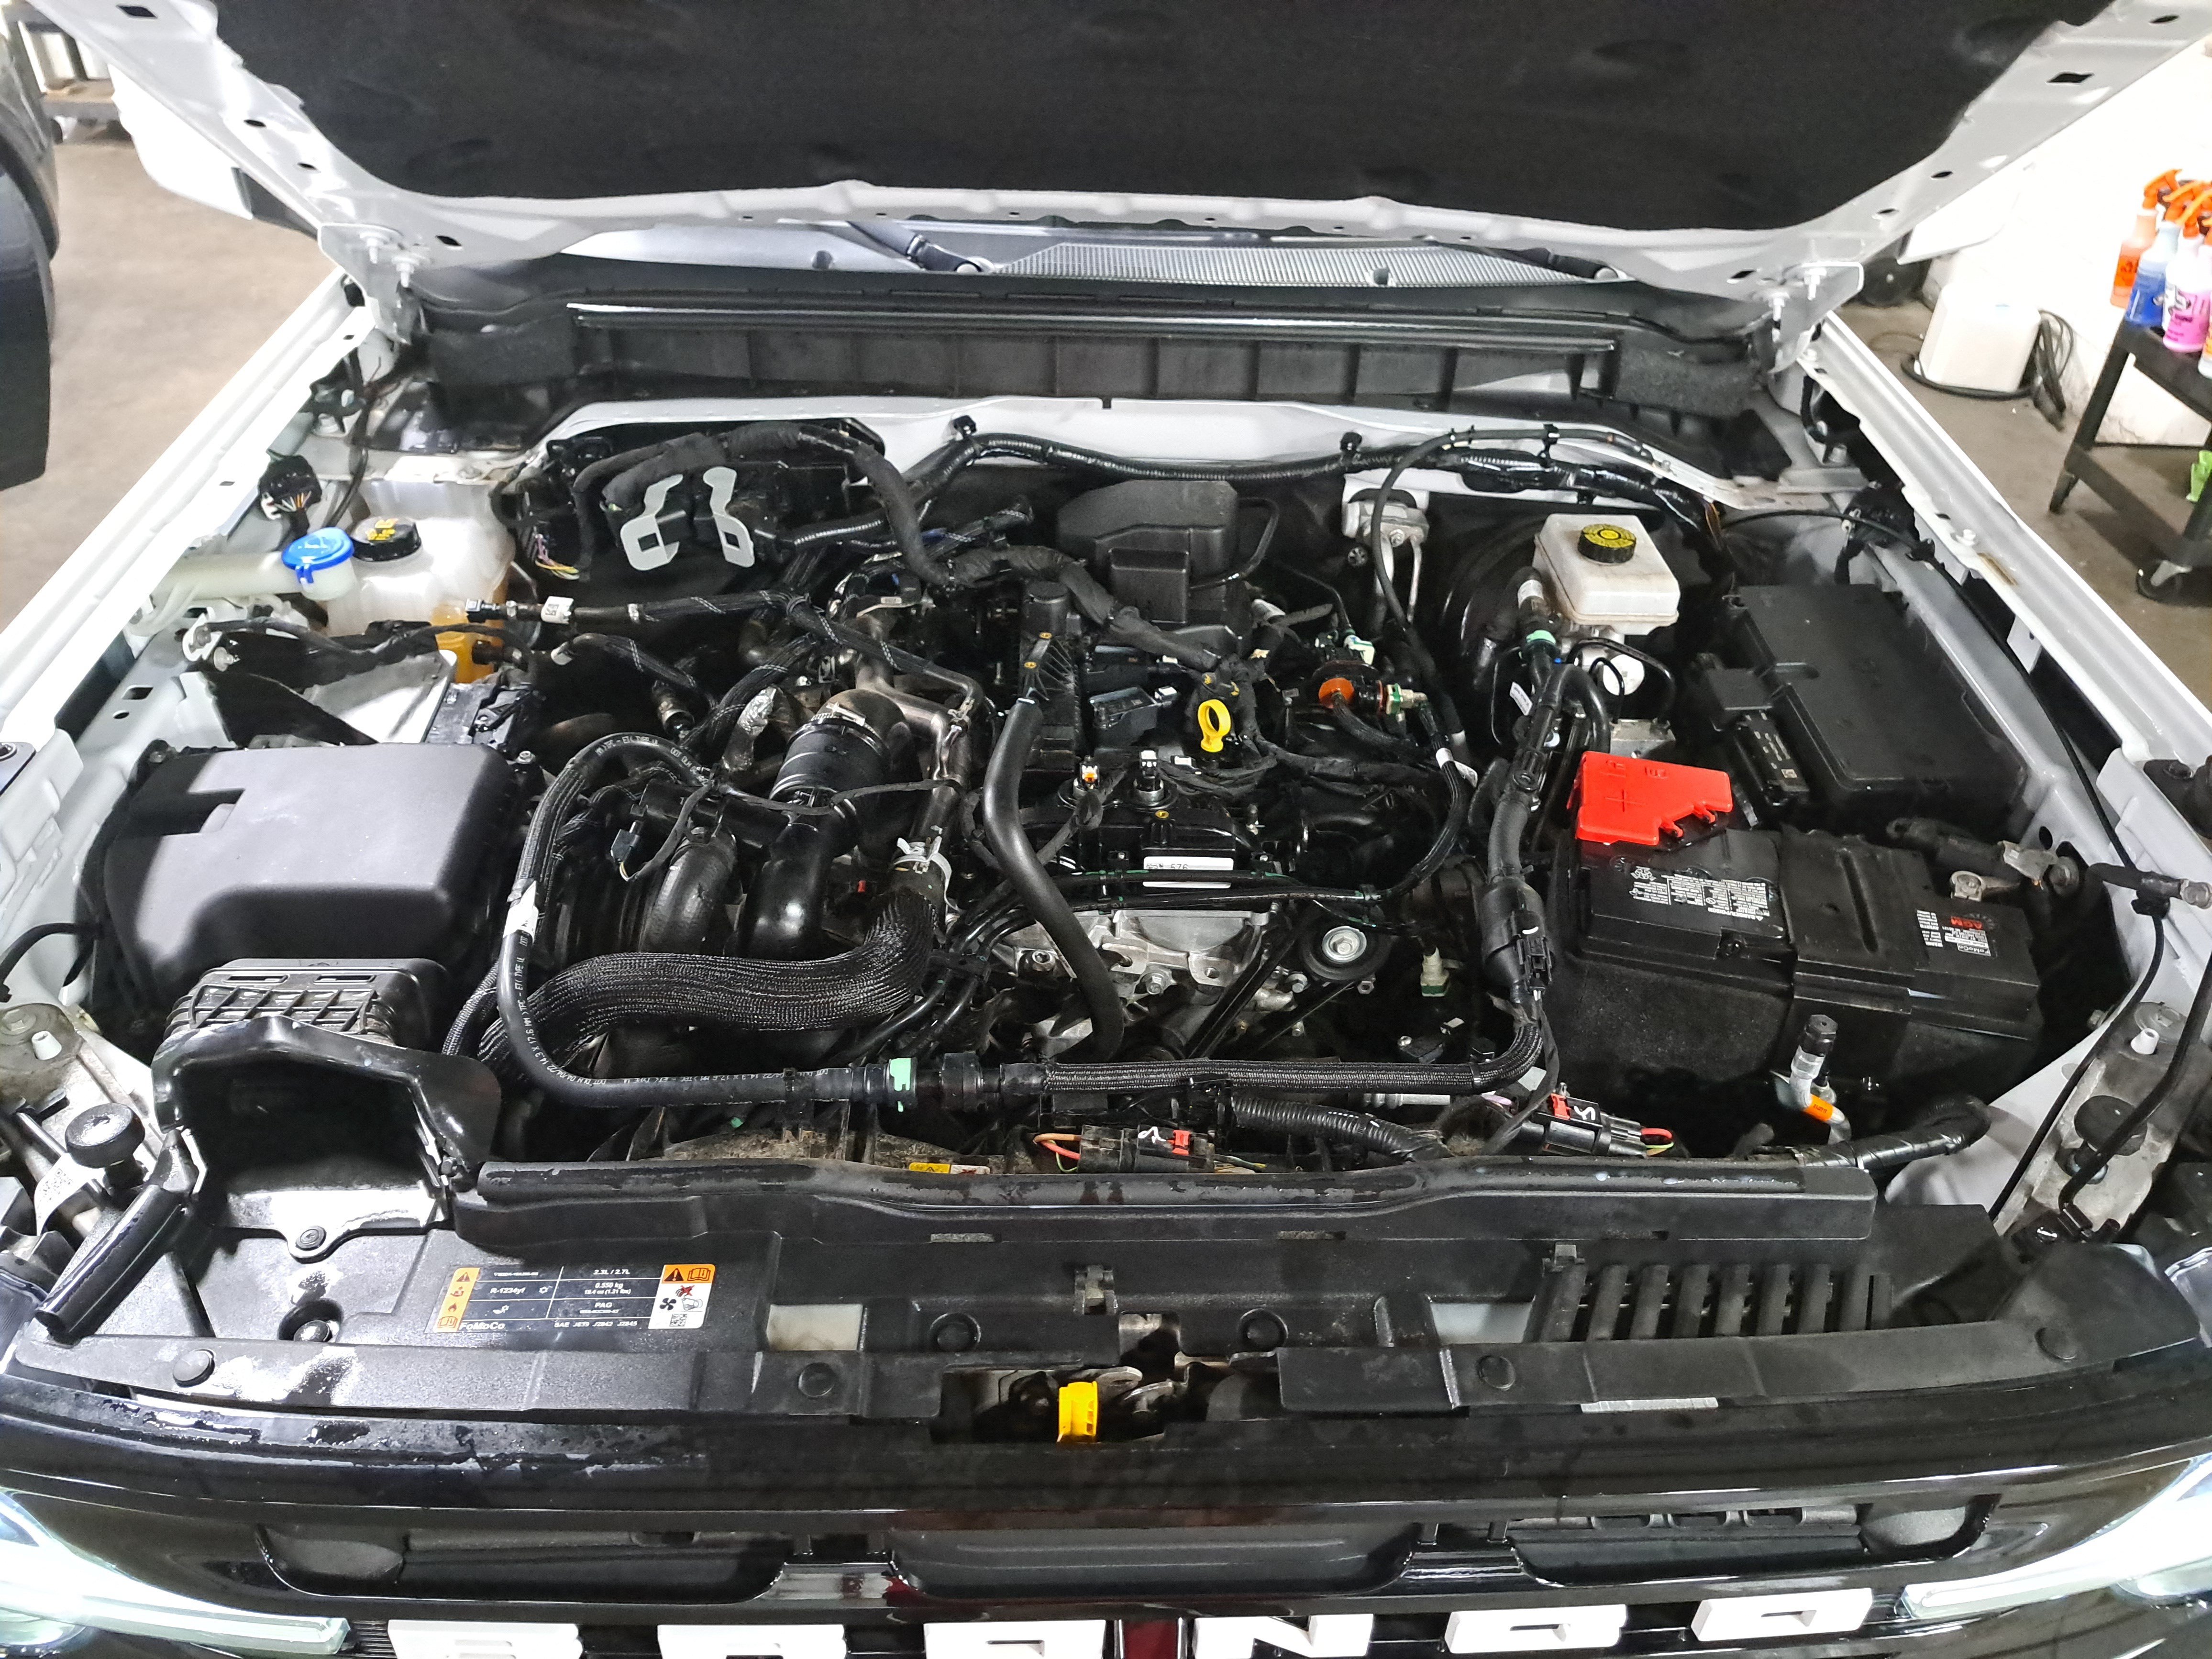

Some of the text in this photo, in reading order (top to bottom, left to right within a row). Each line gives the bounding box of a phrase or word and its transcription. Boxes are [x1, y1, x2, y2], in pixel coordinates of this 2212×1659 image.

[1951, 916, 1982, 929] AGM
[1958, 945, 1989, 954] FoMoCo
[458, 1321, 506, 1330] FoMoCo
